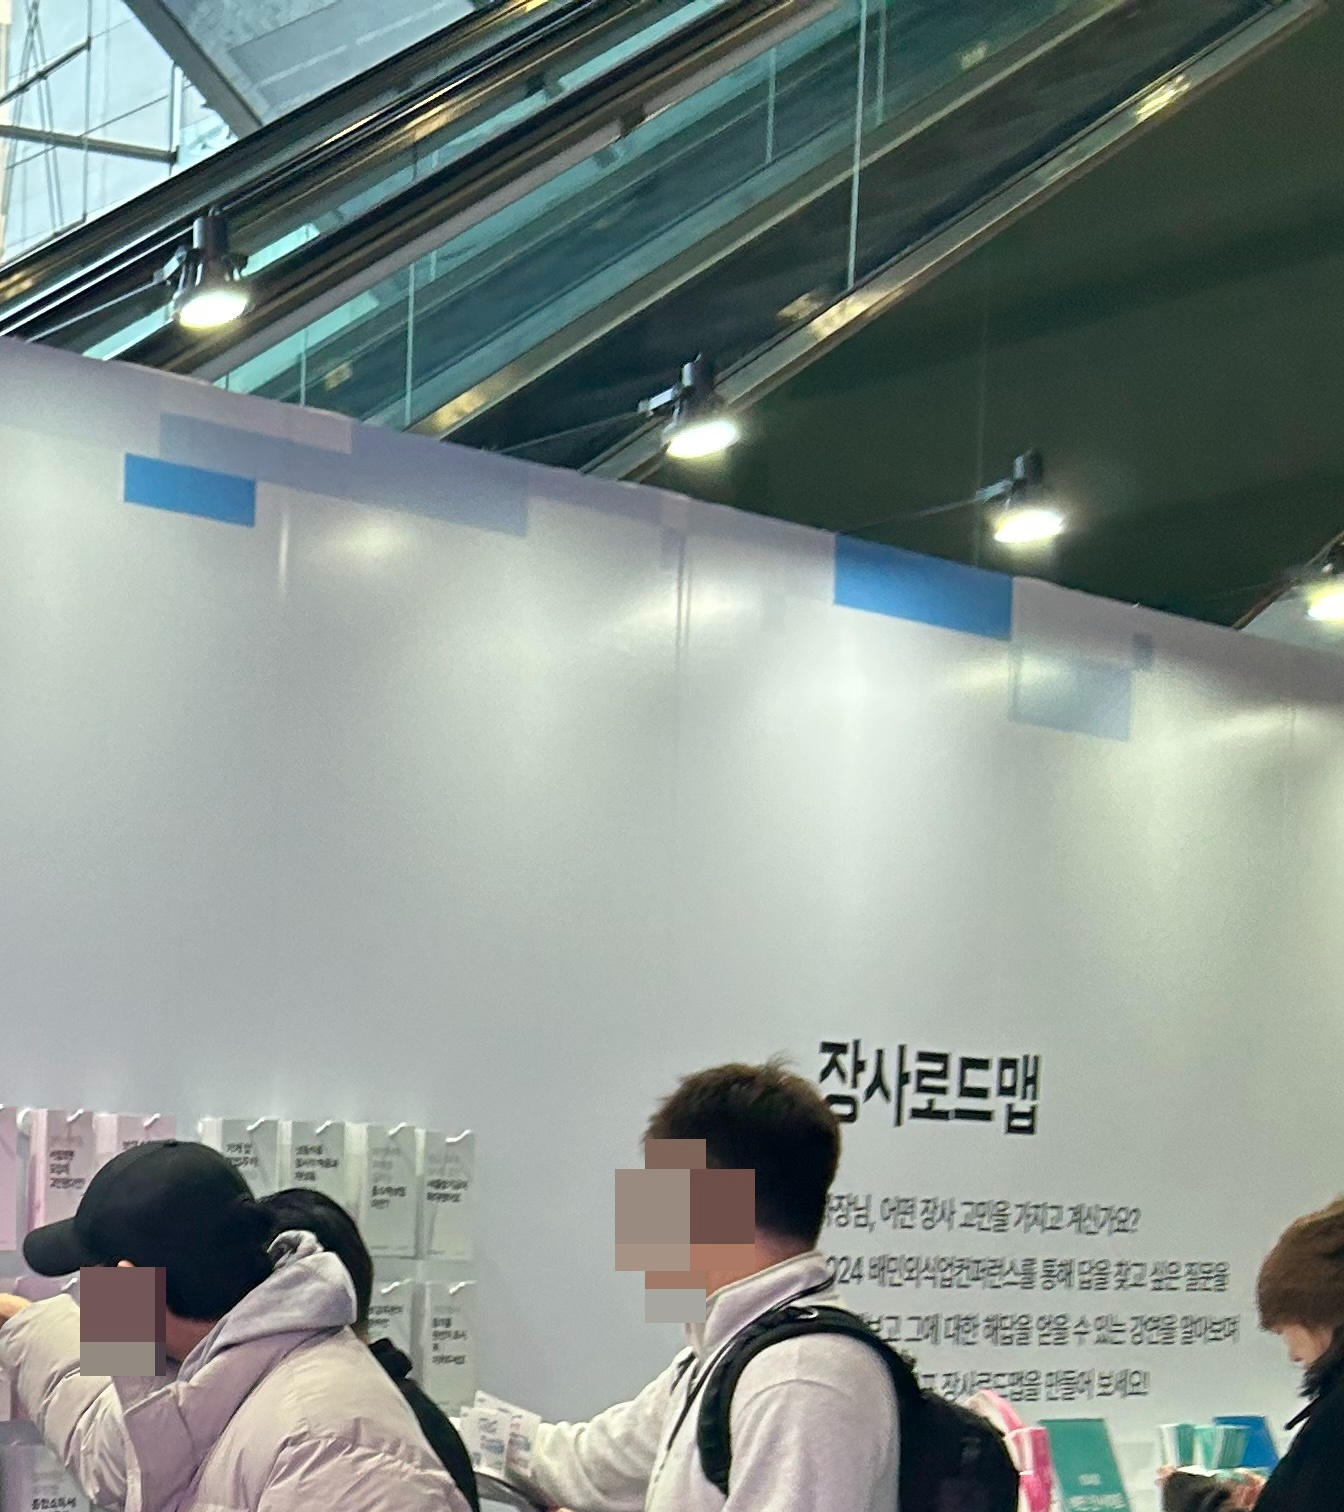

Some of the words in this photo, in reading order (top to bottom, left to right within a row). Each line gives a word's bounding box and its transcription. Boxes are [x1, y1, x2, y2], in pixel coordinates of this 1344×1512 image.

[819, 1038, 1041, 1136] 장사로드맵
[880, 1196, 917, 1230] 어떤
[920, 1196, 956, 1232] 장사
[960, 1199, 1012, 1233] 고민을
[1013, 1201, 1063, 1235] 가지고
[1066, 1202, 1142, 1237] 계신가요?
[1041, 1257, 1075, 1290] 통해
[1078, 1257, 1111, 1291] 답을
[1113, 1259, 1147, 1291] 찾고
[1150, 1260, 1183, 1292] 싶은
[904, 1312, 942, 1345] 그에
[944, 1312, 980, 1346] 대한
[983, 1313, 1034, 1346] 해답을
[1073, 1314, 1092, 1346] 수
[1093, 1313, 1126, 1346] 있는
[1129, 1313, 1179, 1346] 강연을
[1044, 1368, 1095, 1400] 만들어
[1096, 1368, 1151, 1399] 보세요!
